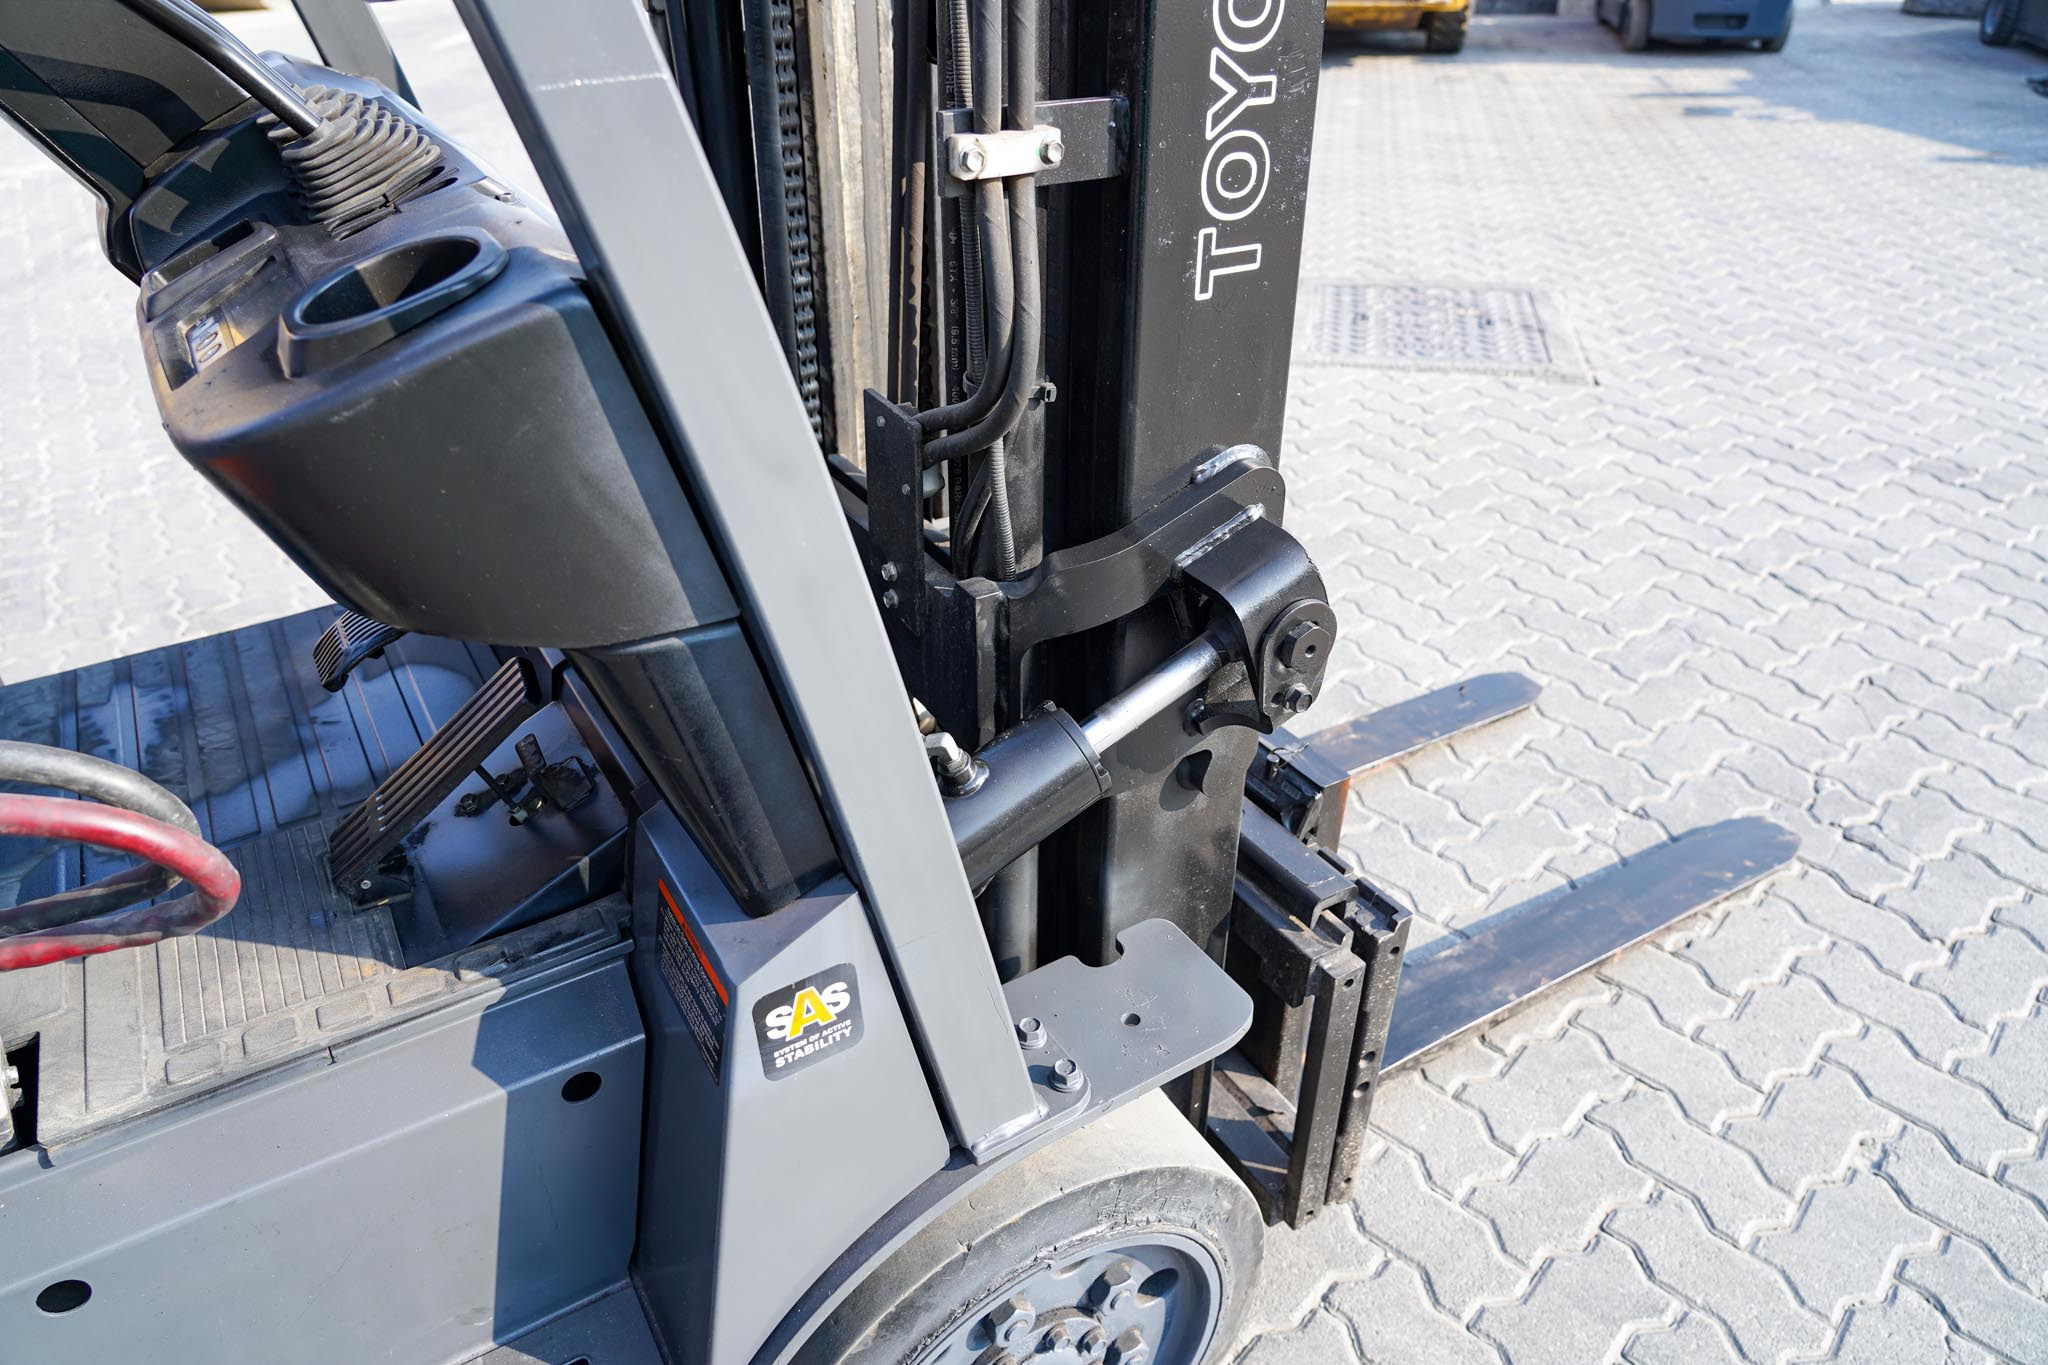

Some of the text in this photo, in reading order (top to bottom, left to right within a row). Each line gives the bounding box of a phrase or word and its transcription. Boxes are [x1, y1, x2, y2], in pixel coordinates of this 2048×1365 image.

[765, 981, 851, 1042] SAS
[773, 1019, 852, 1058] SYSTEM OF ACTIVE
[774, 1026, 853, 1069] STABILITY
